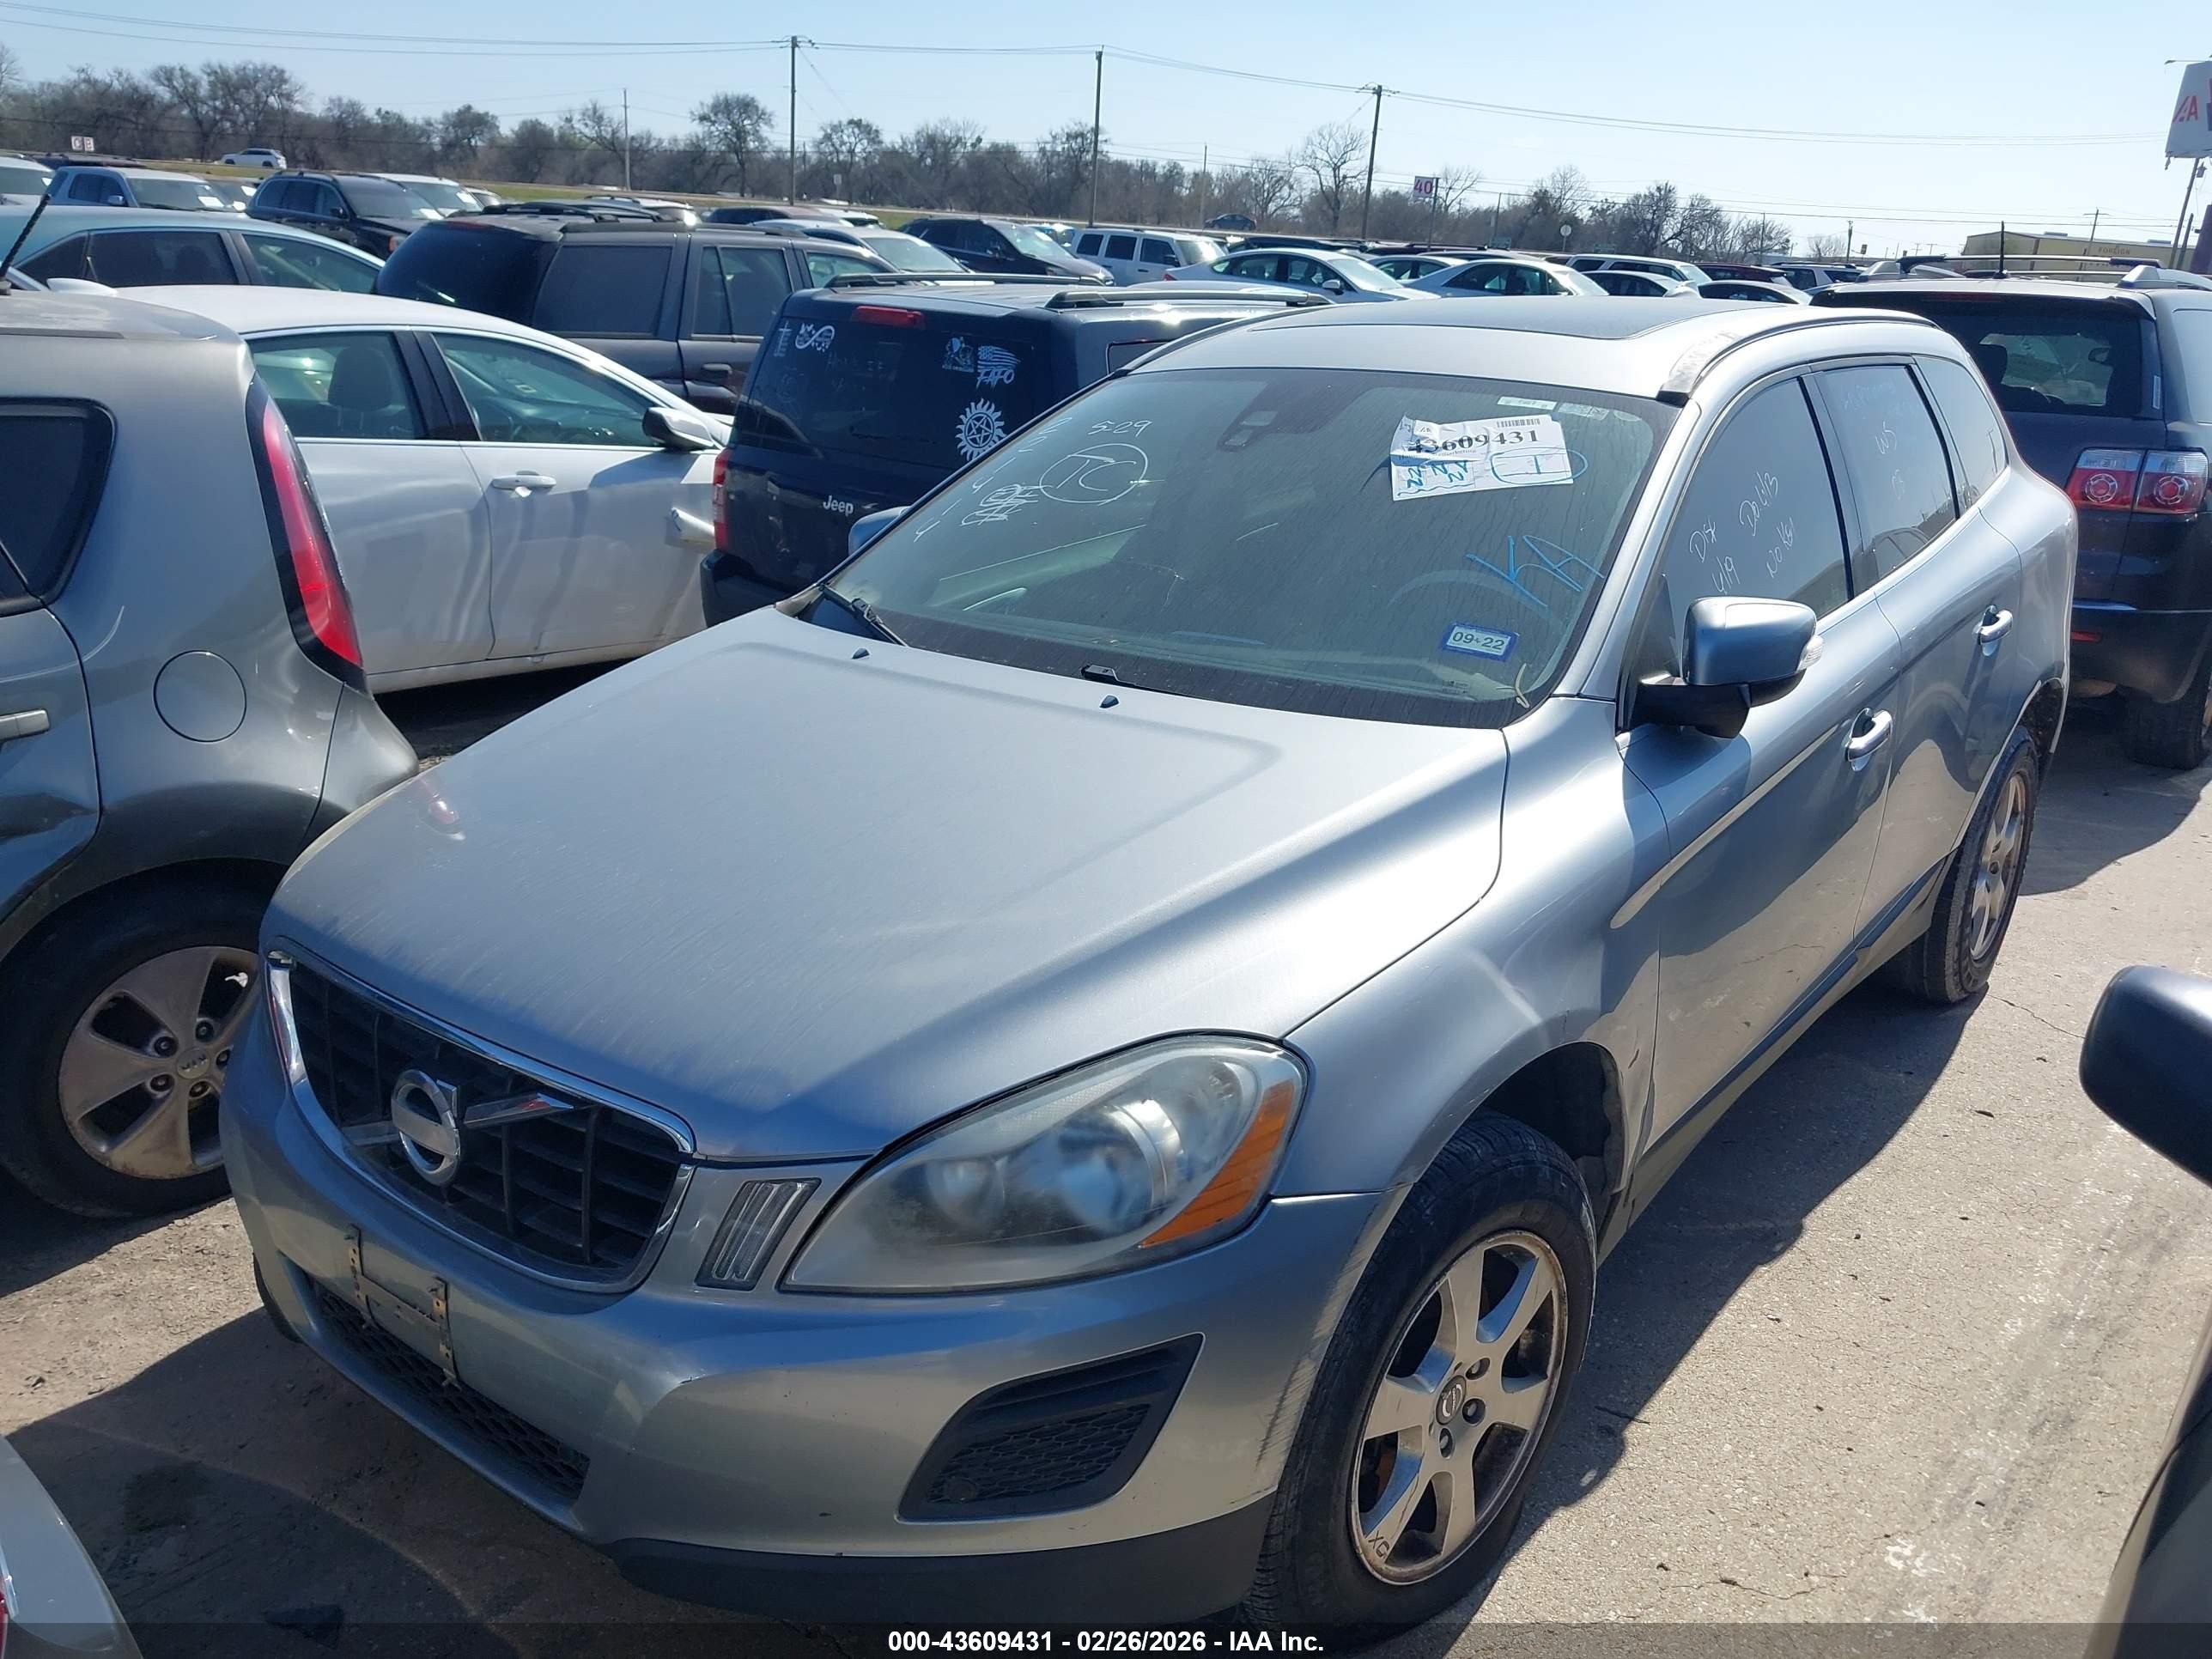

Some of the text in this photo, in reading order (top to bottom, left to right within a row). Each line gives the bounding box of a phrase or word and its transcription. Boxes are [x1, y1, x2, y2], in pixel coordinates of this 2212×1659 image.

[1414, 179, 1433, 194] 40
[1408, 429, 1540, 453] 43609431
[823, 495, 854, 517] Jeep
